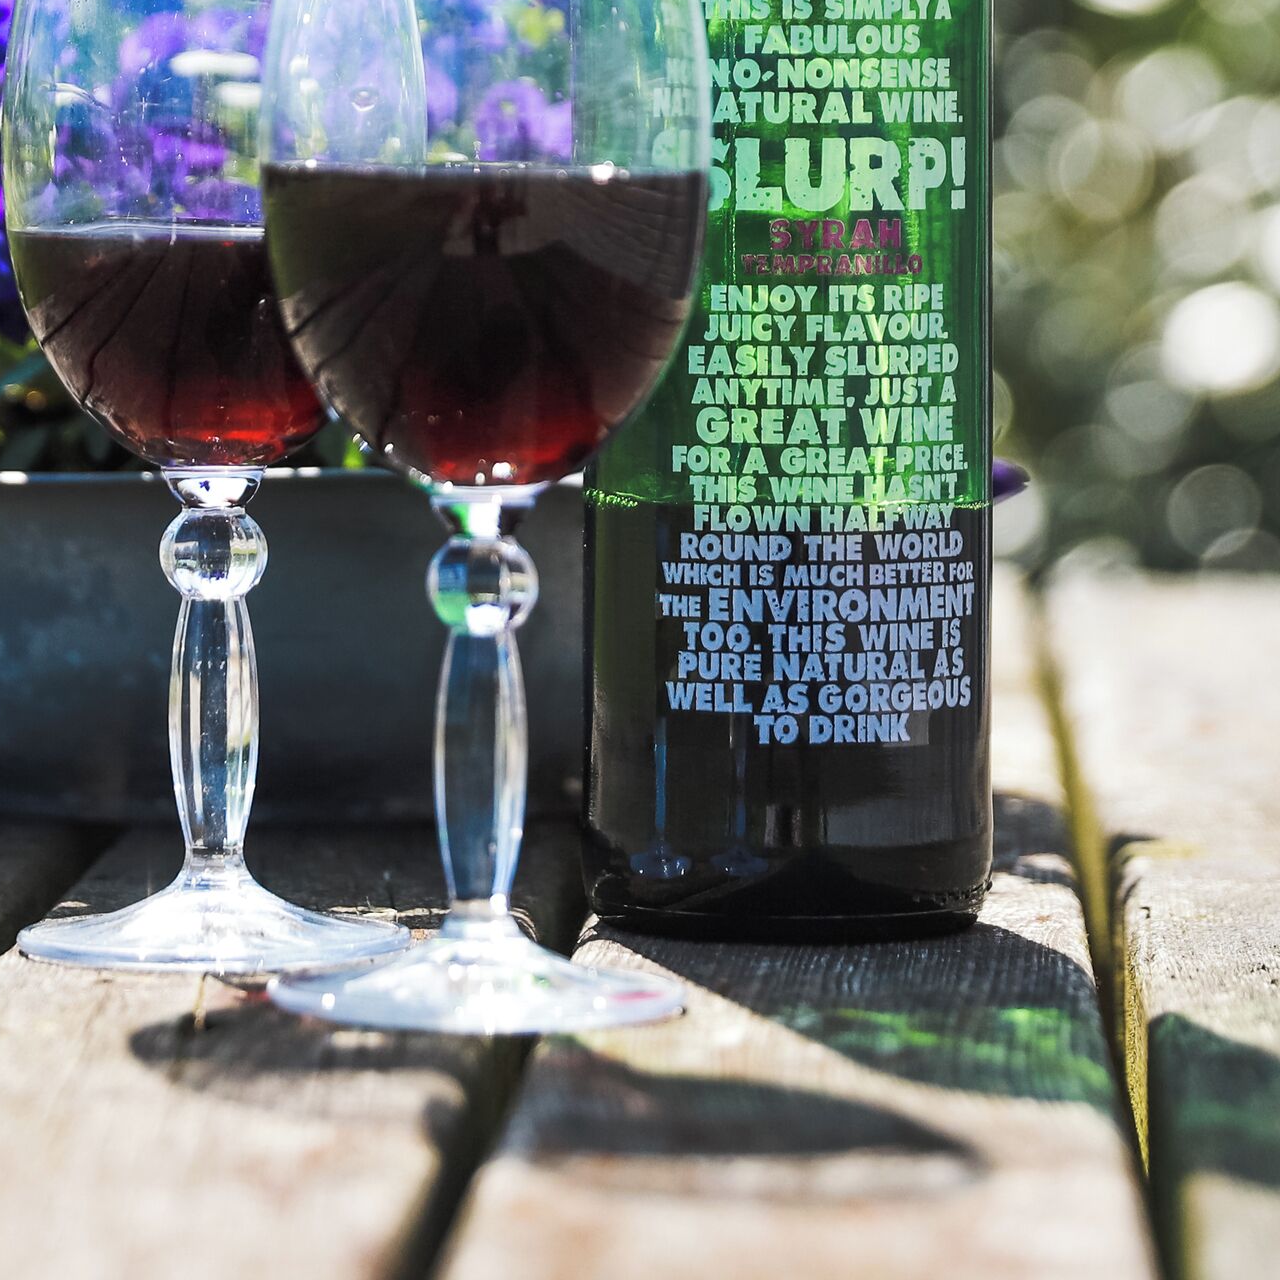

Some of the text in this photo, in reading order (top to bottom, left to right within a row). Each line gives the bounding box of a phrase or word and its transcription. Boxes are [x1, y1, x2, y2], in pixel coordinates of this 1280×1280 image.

[745, 24, 920, 55] FABULOUS
[708, 58, 950, 89] NO-NONSENSE
[712, 91, 872, 124] ATURAL
[879, 90, 963, 123] WINE.
[770, 218, 902, 250] SYRAH
[741, 254, 923, 275] TEMPRANILLO
[710, 283, 944, 313] ENJOY ITS RIPE
[704, 314, 796, 342] JUICY
[688, 344, 959, 376] EASILY SLURPED
[691, 376, 957, 408] ANYTIME, JUST A
[696, 406, 953, 445] GREAT WINE
[671, 443, 968, 474] FOR A GREAT PRICE.
[689, 473, 957, 503] THIS WINE HASN'T
[693, 502, 955, 532] FLOWN HALFWAY
[680, 530, 963, 561] ROUND THE WORLD
[662, 561, 974, 587] WHICH IS MUCH BETTER FOR
[659, 582, 975, 623] THE ENVIRONMENT
[682, 618, 961, 653] TOO. THIS WINE IS
[677, 647, 964, 681] PURE NATURAL AS
[665, 675, 971, 714] WELL AS GORGEOUS
[754, 713, 911, 745] TO DRINK
